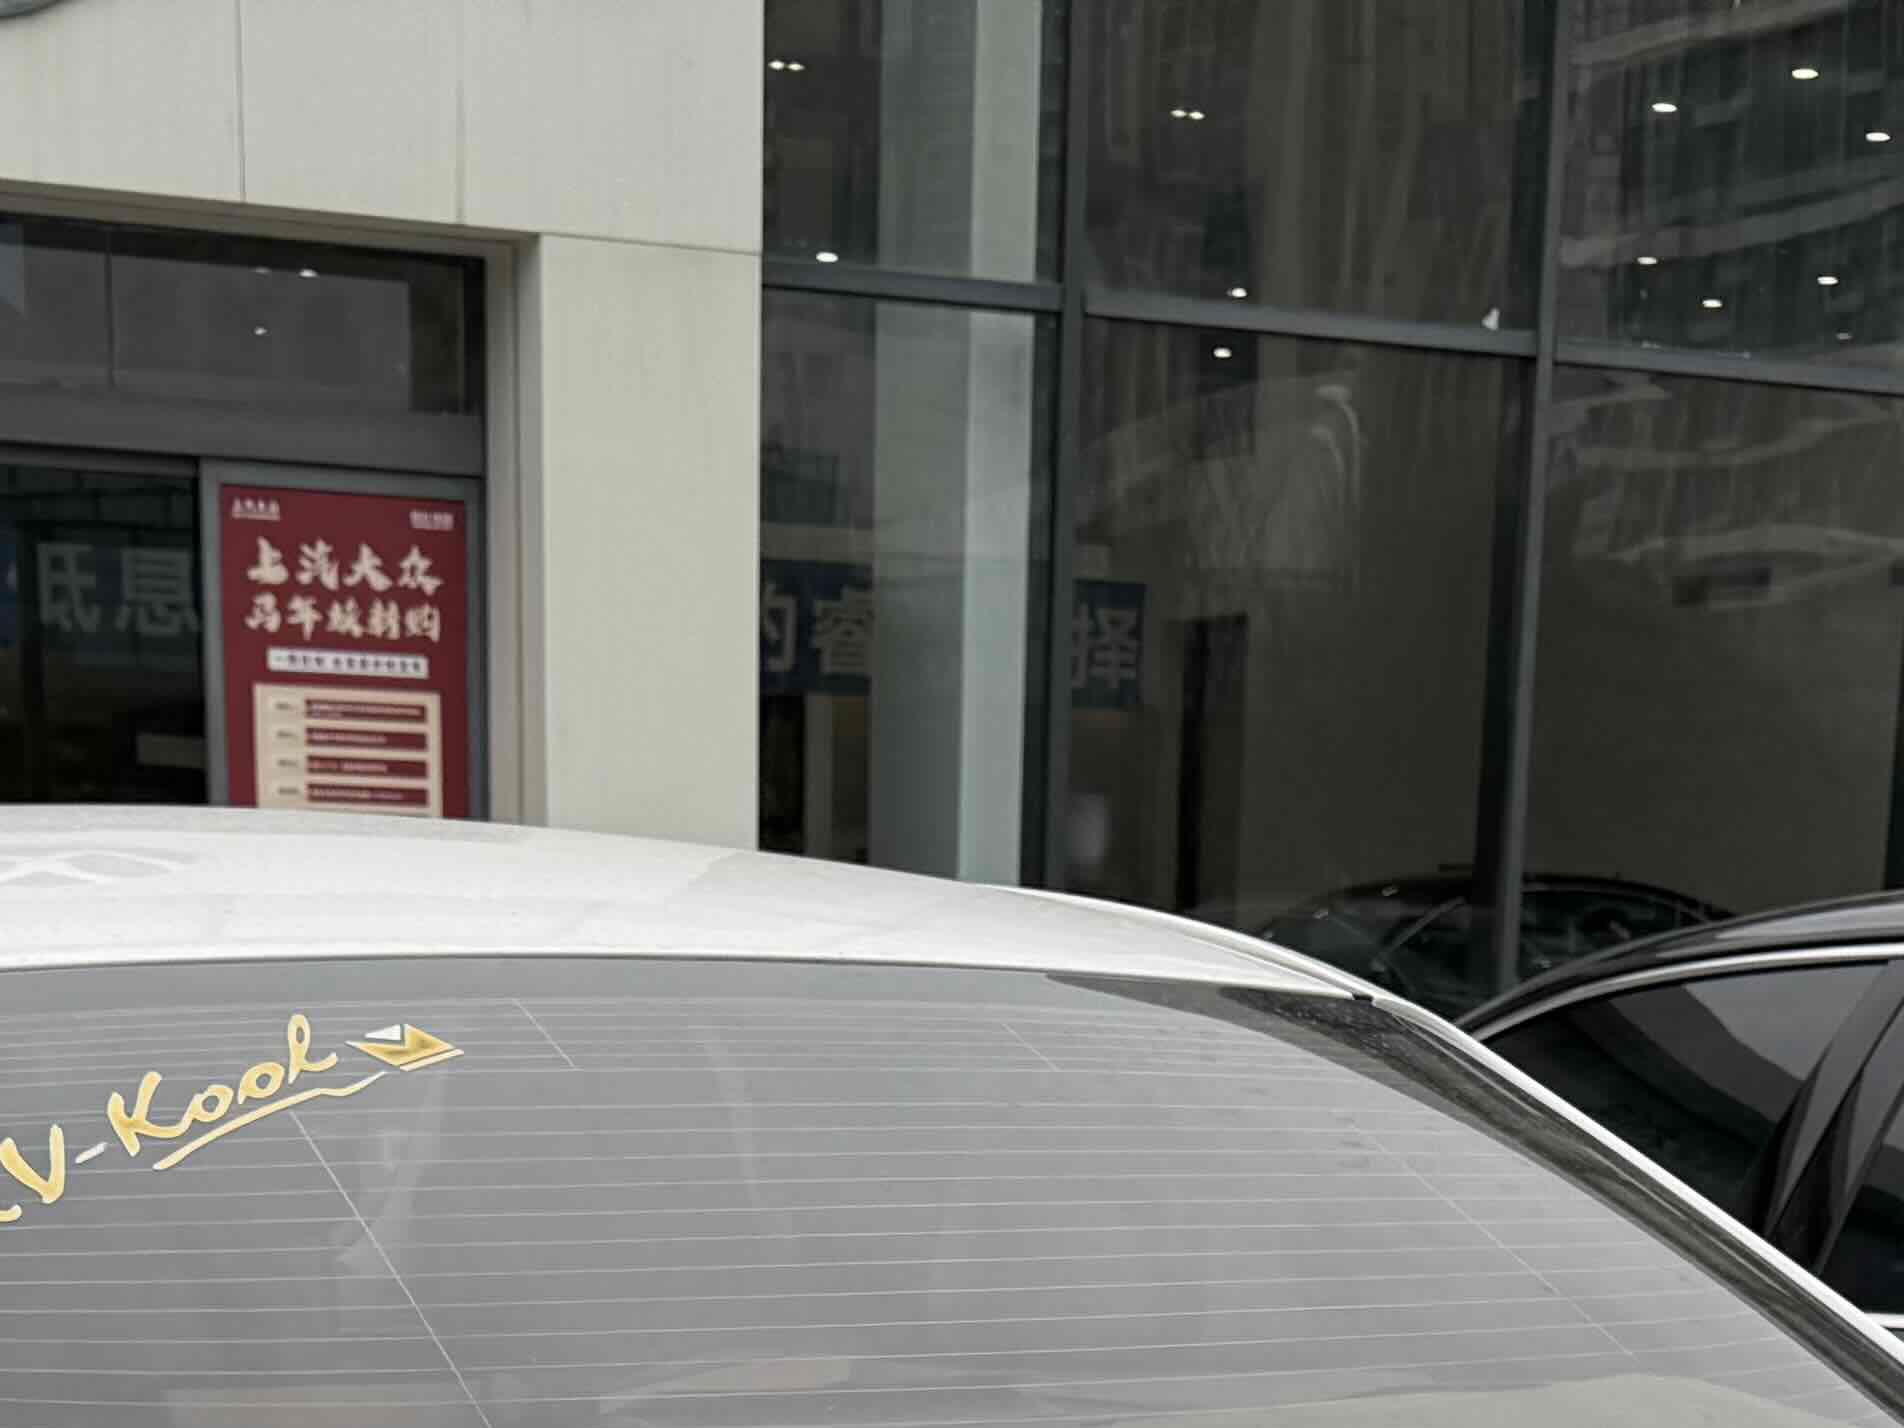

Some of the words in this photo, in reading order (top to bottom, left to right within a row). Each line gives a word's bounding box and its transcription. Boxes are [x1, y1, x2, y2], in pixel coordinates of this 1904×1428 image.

[247, 536, 445, 595] 上汽大众
[244, 591, 441, 643] 马年焕新购
